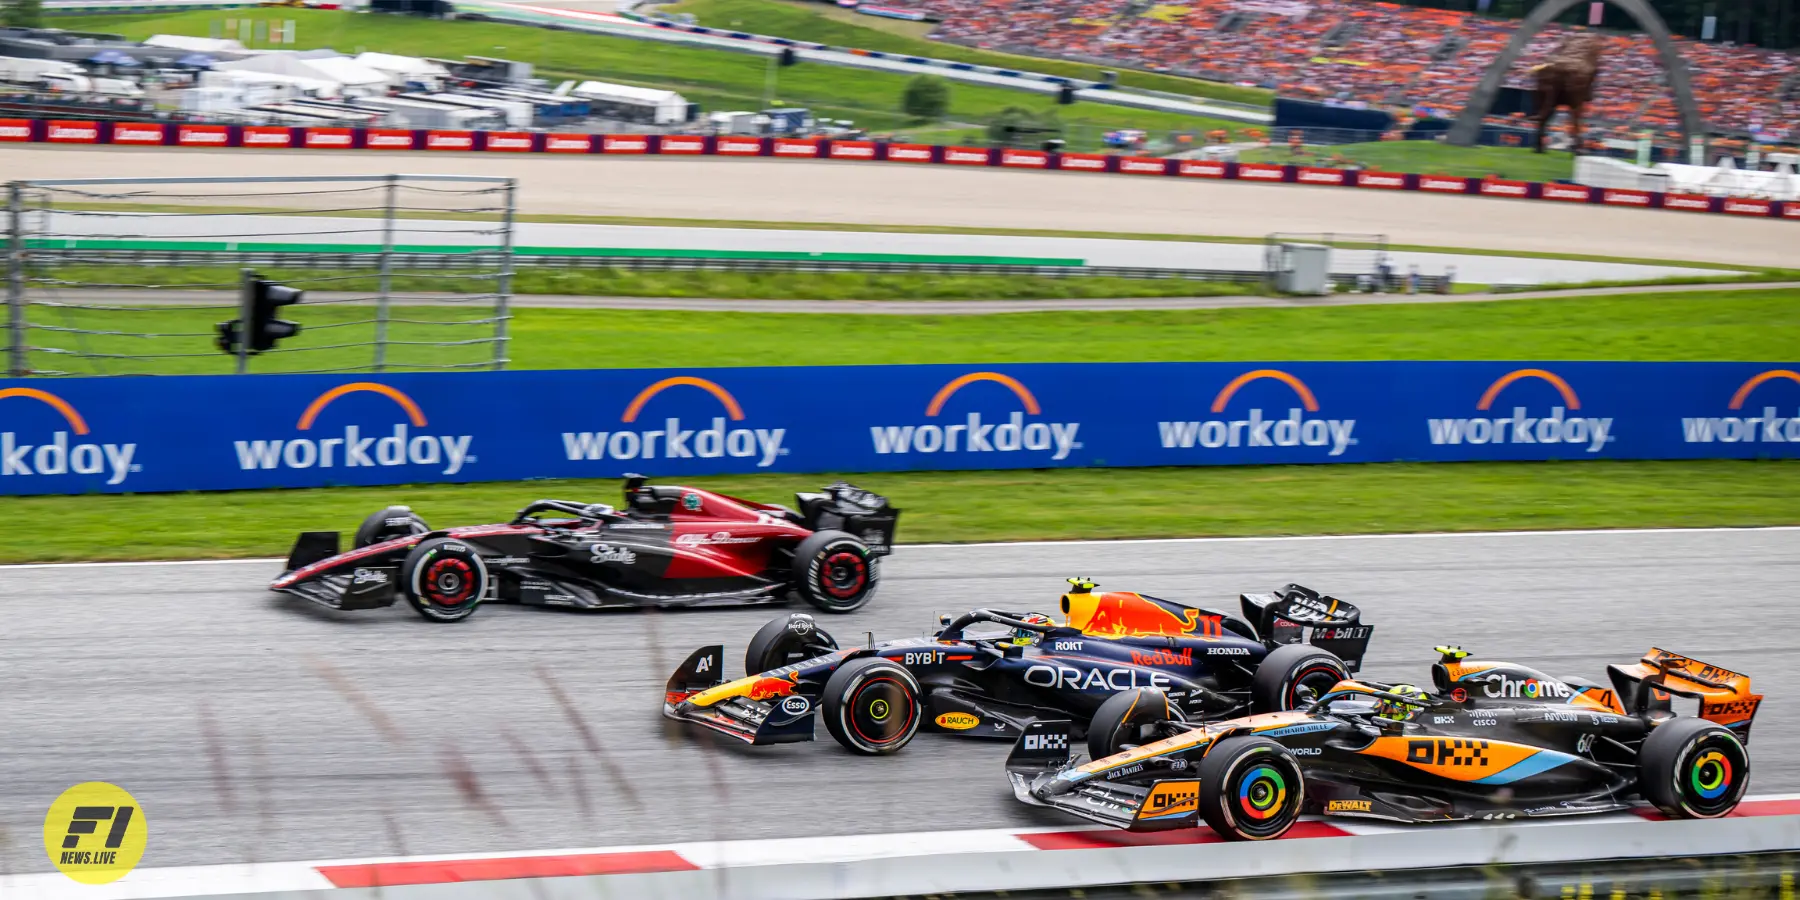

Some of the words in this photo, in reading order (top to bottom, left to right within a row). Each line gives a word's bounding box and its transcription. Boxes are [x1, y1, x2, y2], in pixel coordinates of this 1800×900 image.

[870, 411, 1081, 460] workday
[1159, 407, 1356, 456] workday
[1428, 406, 1613, 452] workday
[234, 424, 473, 475] workday
[562, 417, 787, 467] workday
[1198, 615, 1223, 637] 11
[1312, 627, 1354, 639] Mobil
[1055, 641, 1083, 651] ROKT
[1207, 647, 1251, 656] HONDA
[695, 654, 714, 673] A1
[905, 649, 946, 665] BYBIT
[1130, 648, 1163, 666] Red
[1161, 647, 1193, 666] Bull
[1023, 665, 1172, 692] ORACLE
[1483, 674, 1571, 698] Chrome
[786, 700, 806, 710] Esso
[946, 716, 975, 725] RAUCH
[1273, 726, 1305, 736] RICHARD
[1307, 723, 1328, 731] MILLE
[1024, 734, 1068, 750] OKX
[1288, 747, 1322, 755] WORLD
[1405, 739, 1489, 766] OKX
